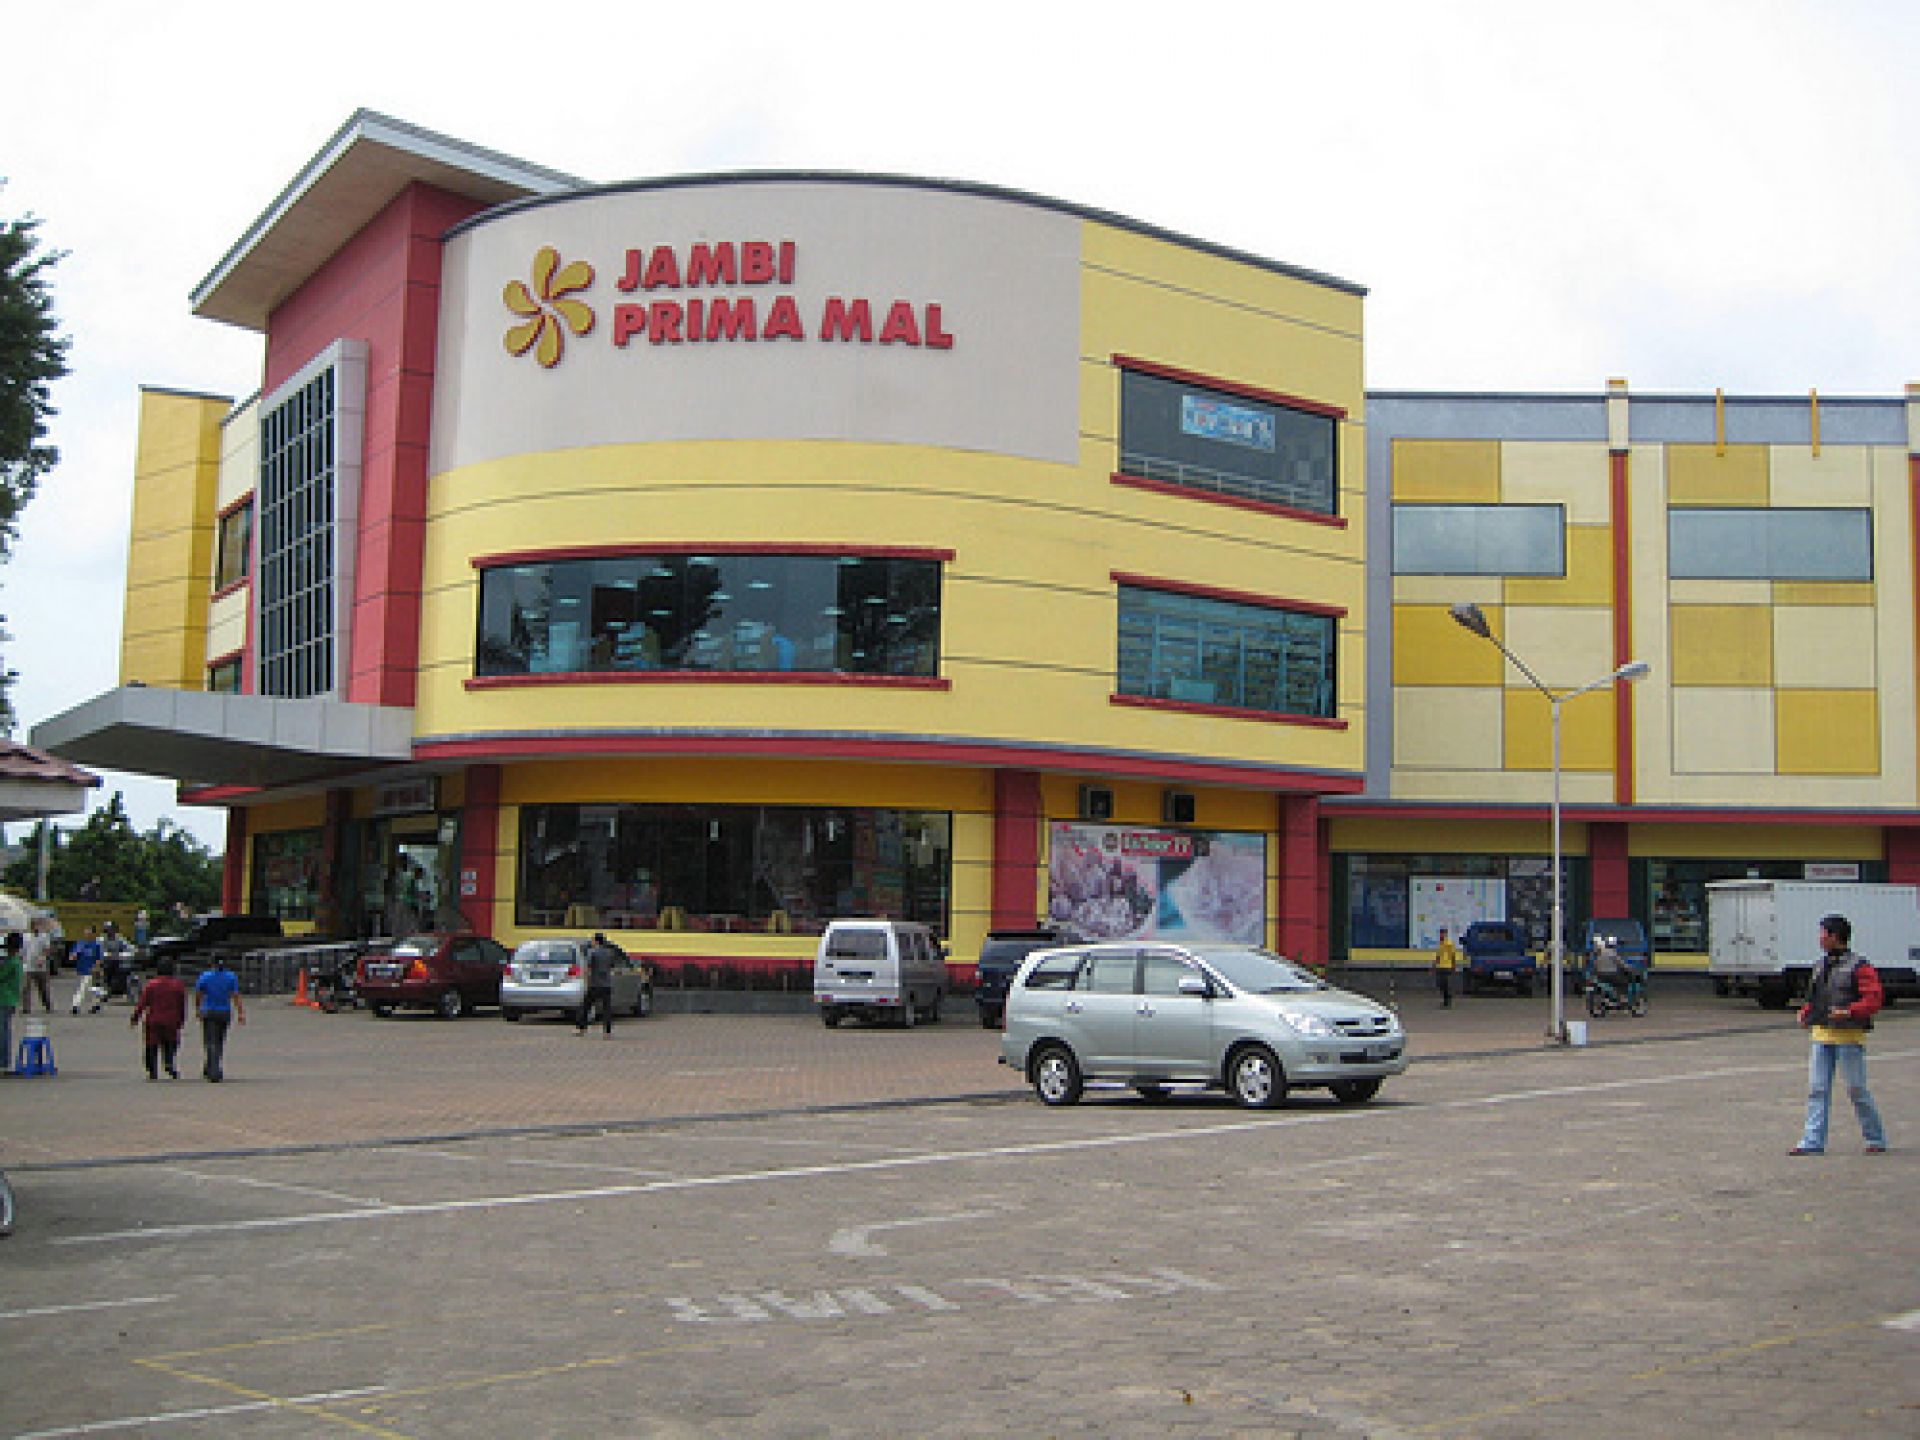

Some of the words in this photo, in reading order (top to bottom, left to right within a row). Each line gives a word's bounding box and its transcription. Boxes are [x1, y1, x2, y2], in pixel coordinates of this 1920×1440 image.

[616, 239, 796, 292] JAMBI
[613, 295, 804, 347] PRIMA
[821, 296, 954, 349] MAL
